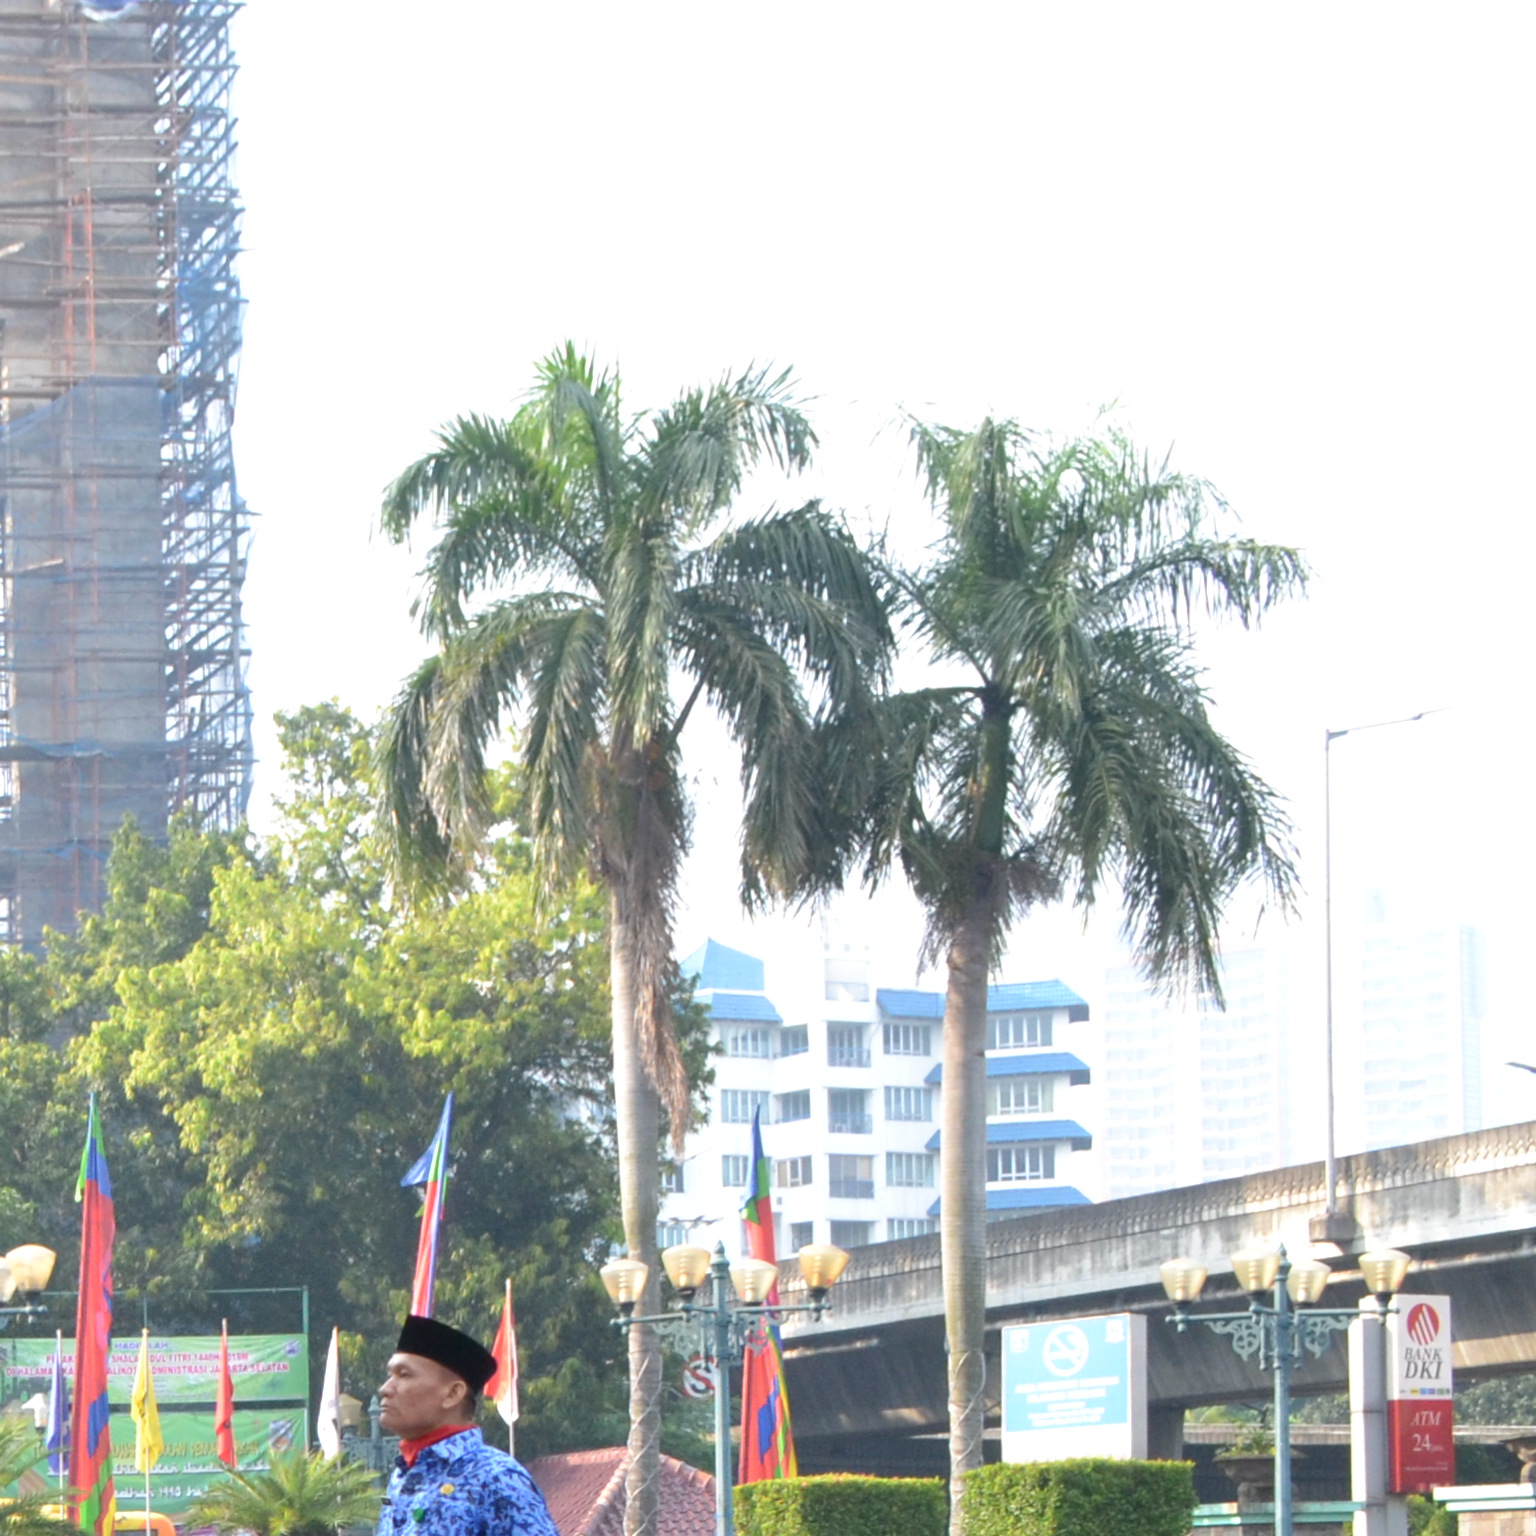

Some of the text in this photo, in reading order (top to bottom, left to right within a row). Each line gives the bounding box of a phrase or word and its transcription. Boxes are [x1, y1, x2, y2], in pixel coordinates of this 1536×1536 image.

[111, 1355, 141, 1363] SHALA
[1404, 1347, 1443, 1361] BANK
[16, 1366, 54, 1376] HALAMA
[150, 1364, 207, 1375] DMINISTRASI
[209, 1363, 248, 1374] JAARTA
[1404, 1360, 1444, 1380] DKI
[1410, 1410, 1442, 1427] ATM
